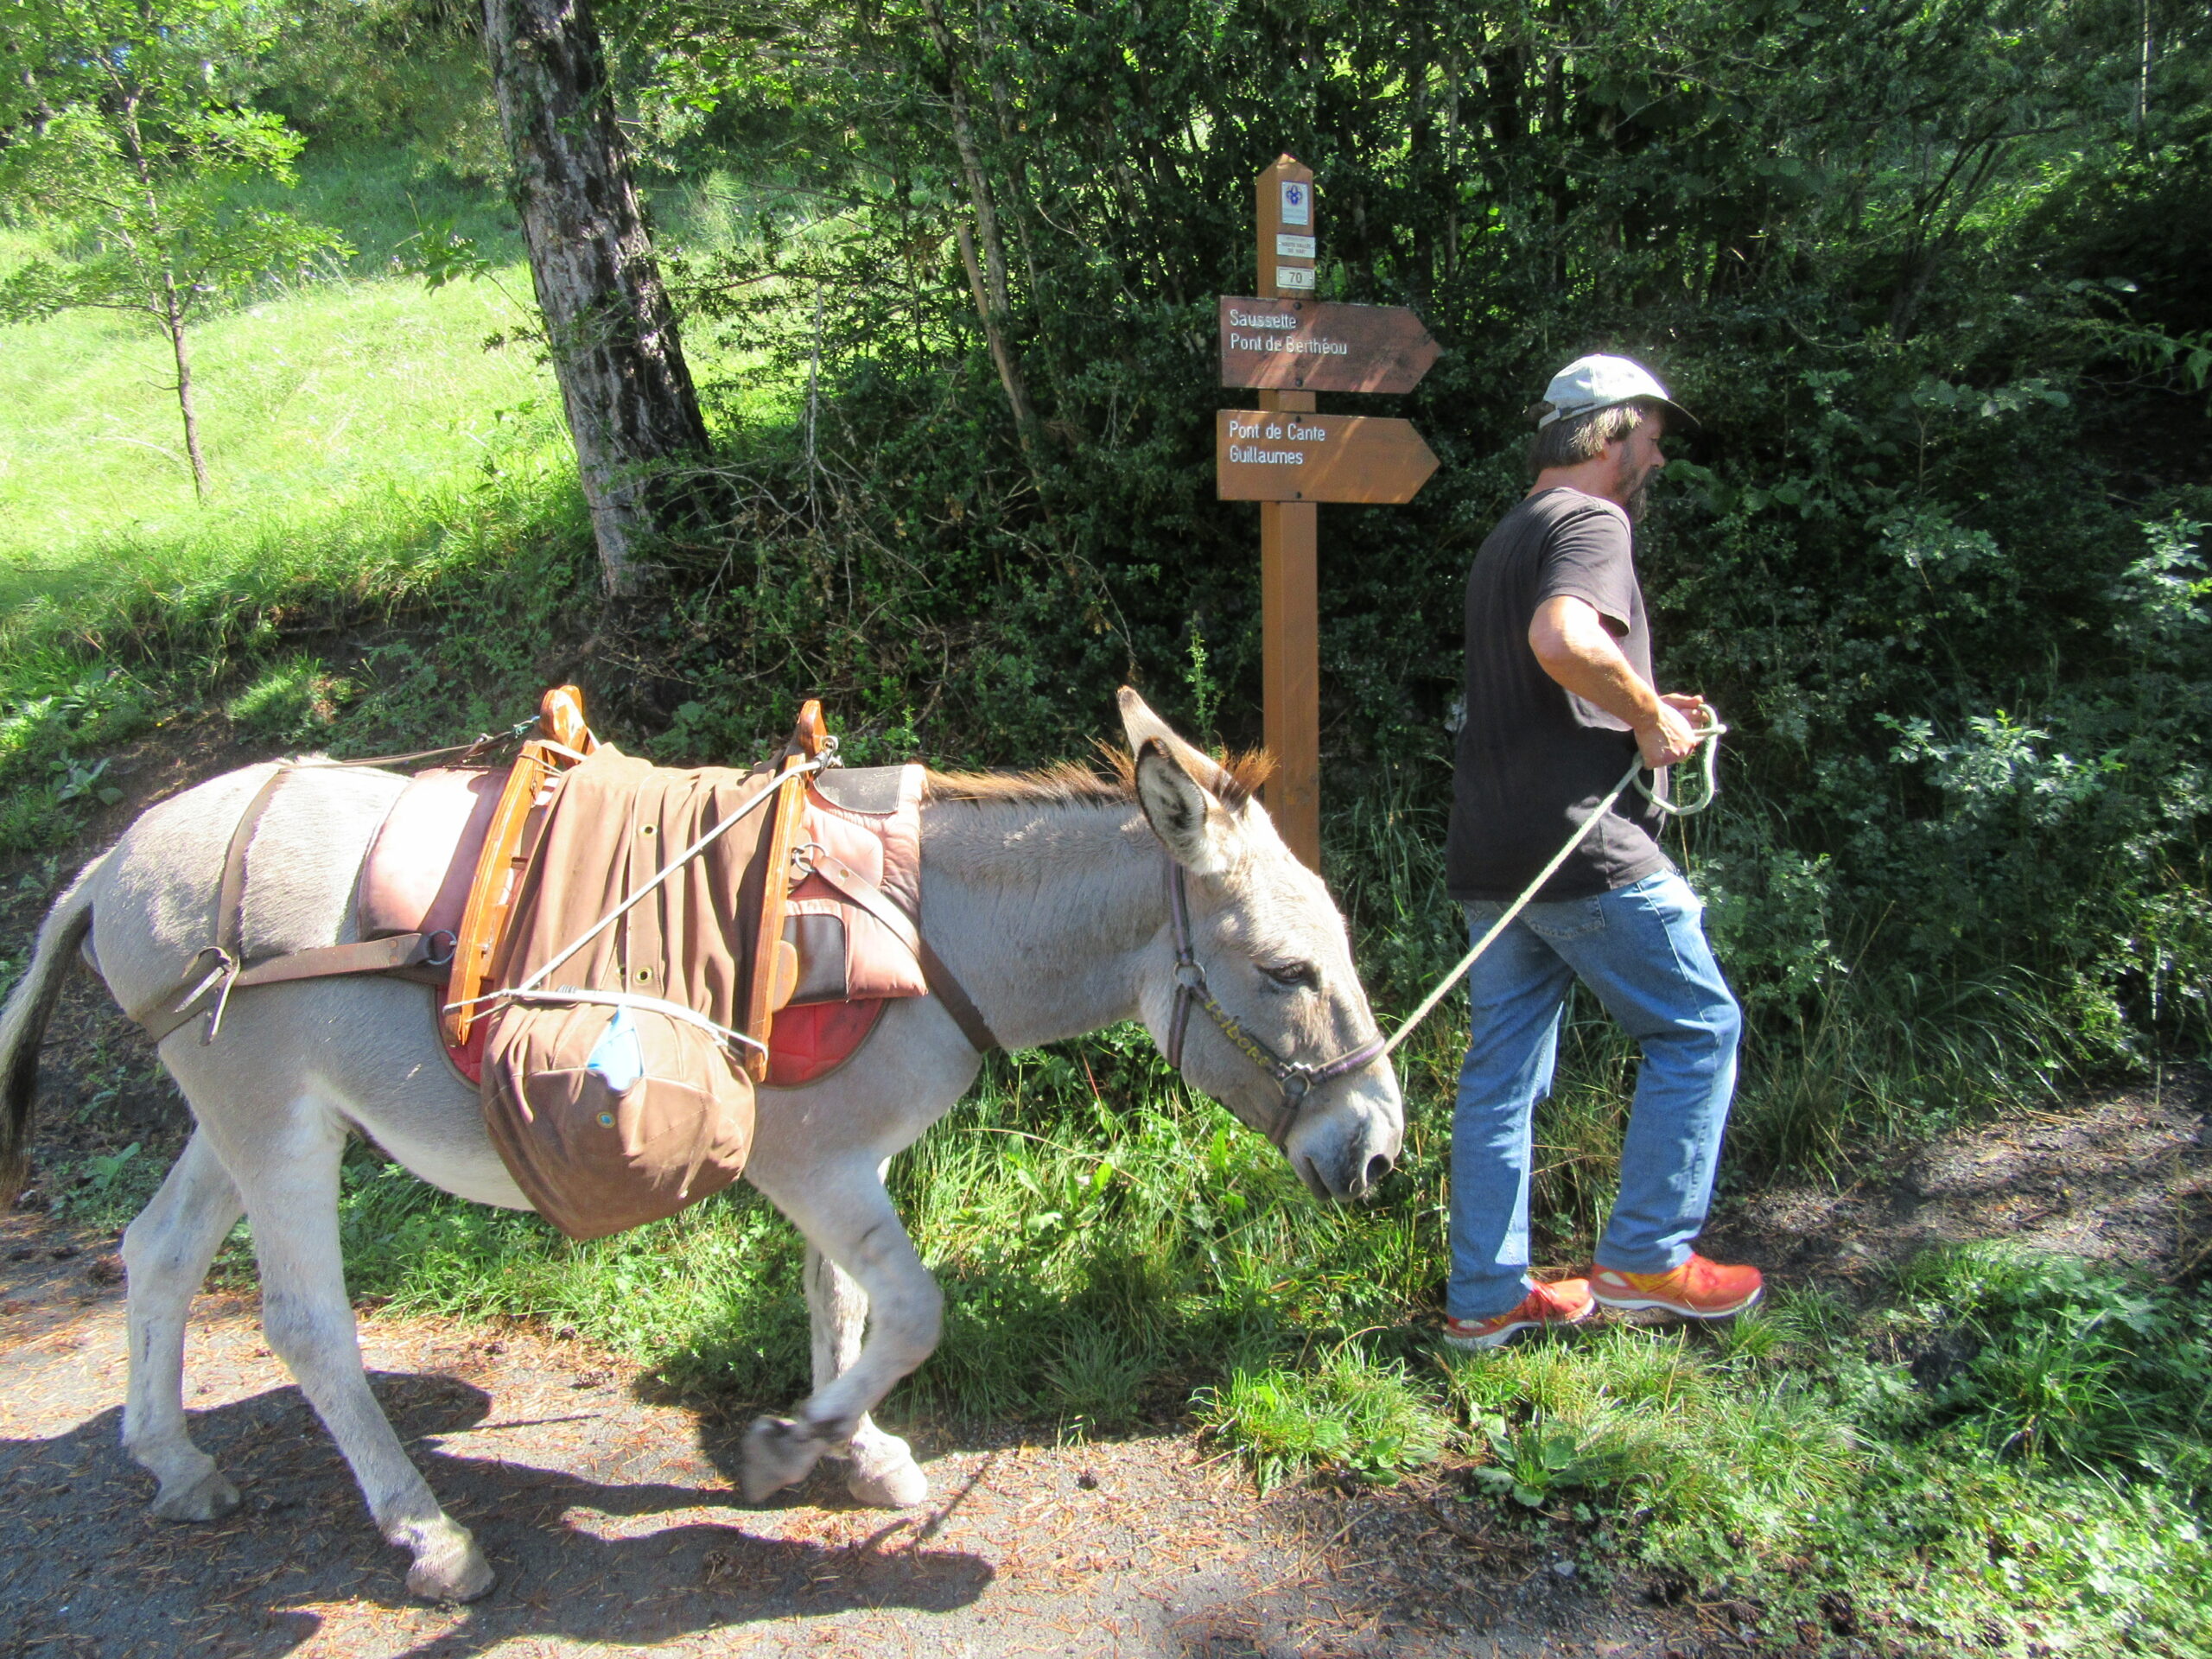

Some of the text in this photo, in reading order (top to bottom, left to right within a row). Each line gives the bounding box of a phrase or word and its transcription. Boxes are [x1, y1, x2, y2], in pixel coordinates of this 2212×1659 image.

[1288, 272, 1303, 283] 70
[1230, 308, 1297, 328] Saussette
[1230, 333, 1348, 354] Pont de Berthéou
[1230, 420, 1326, 442] Pont de Cante
[1230, 444, 1304, 465] Guillaumes
